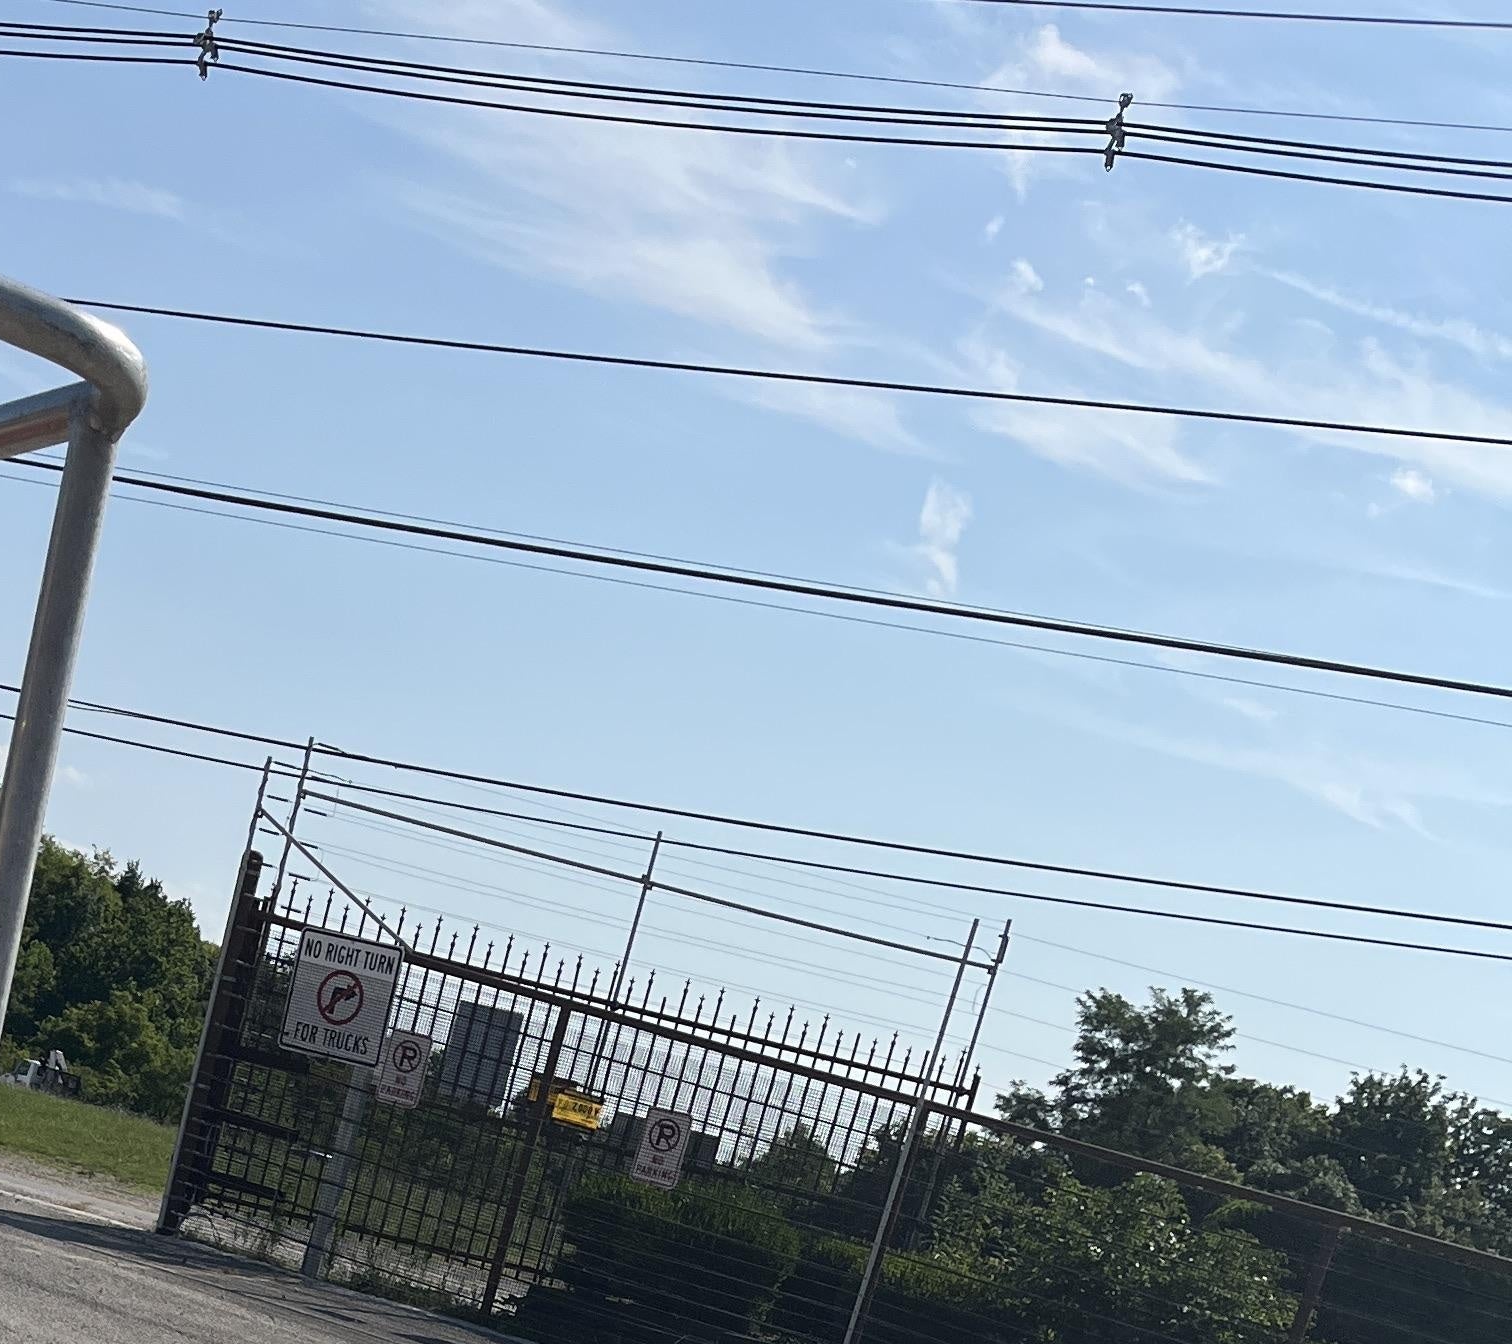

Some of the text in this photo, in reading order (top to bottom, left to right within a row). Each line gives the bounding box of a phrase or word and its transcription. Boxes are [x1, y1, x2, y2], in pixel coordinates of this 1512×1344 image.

[304, 937, 395, 976] NO RIGHT TURN
[293, 1021, 369, 1055] FOR TRUCKS
